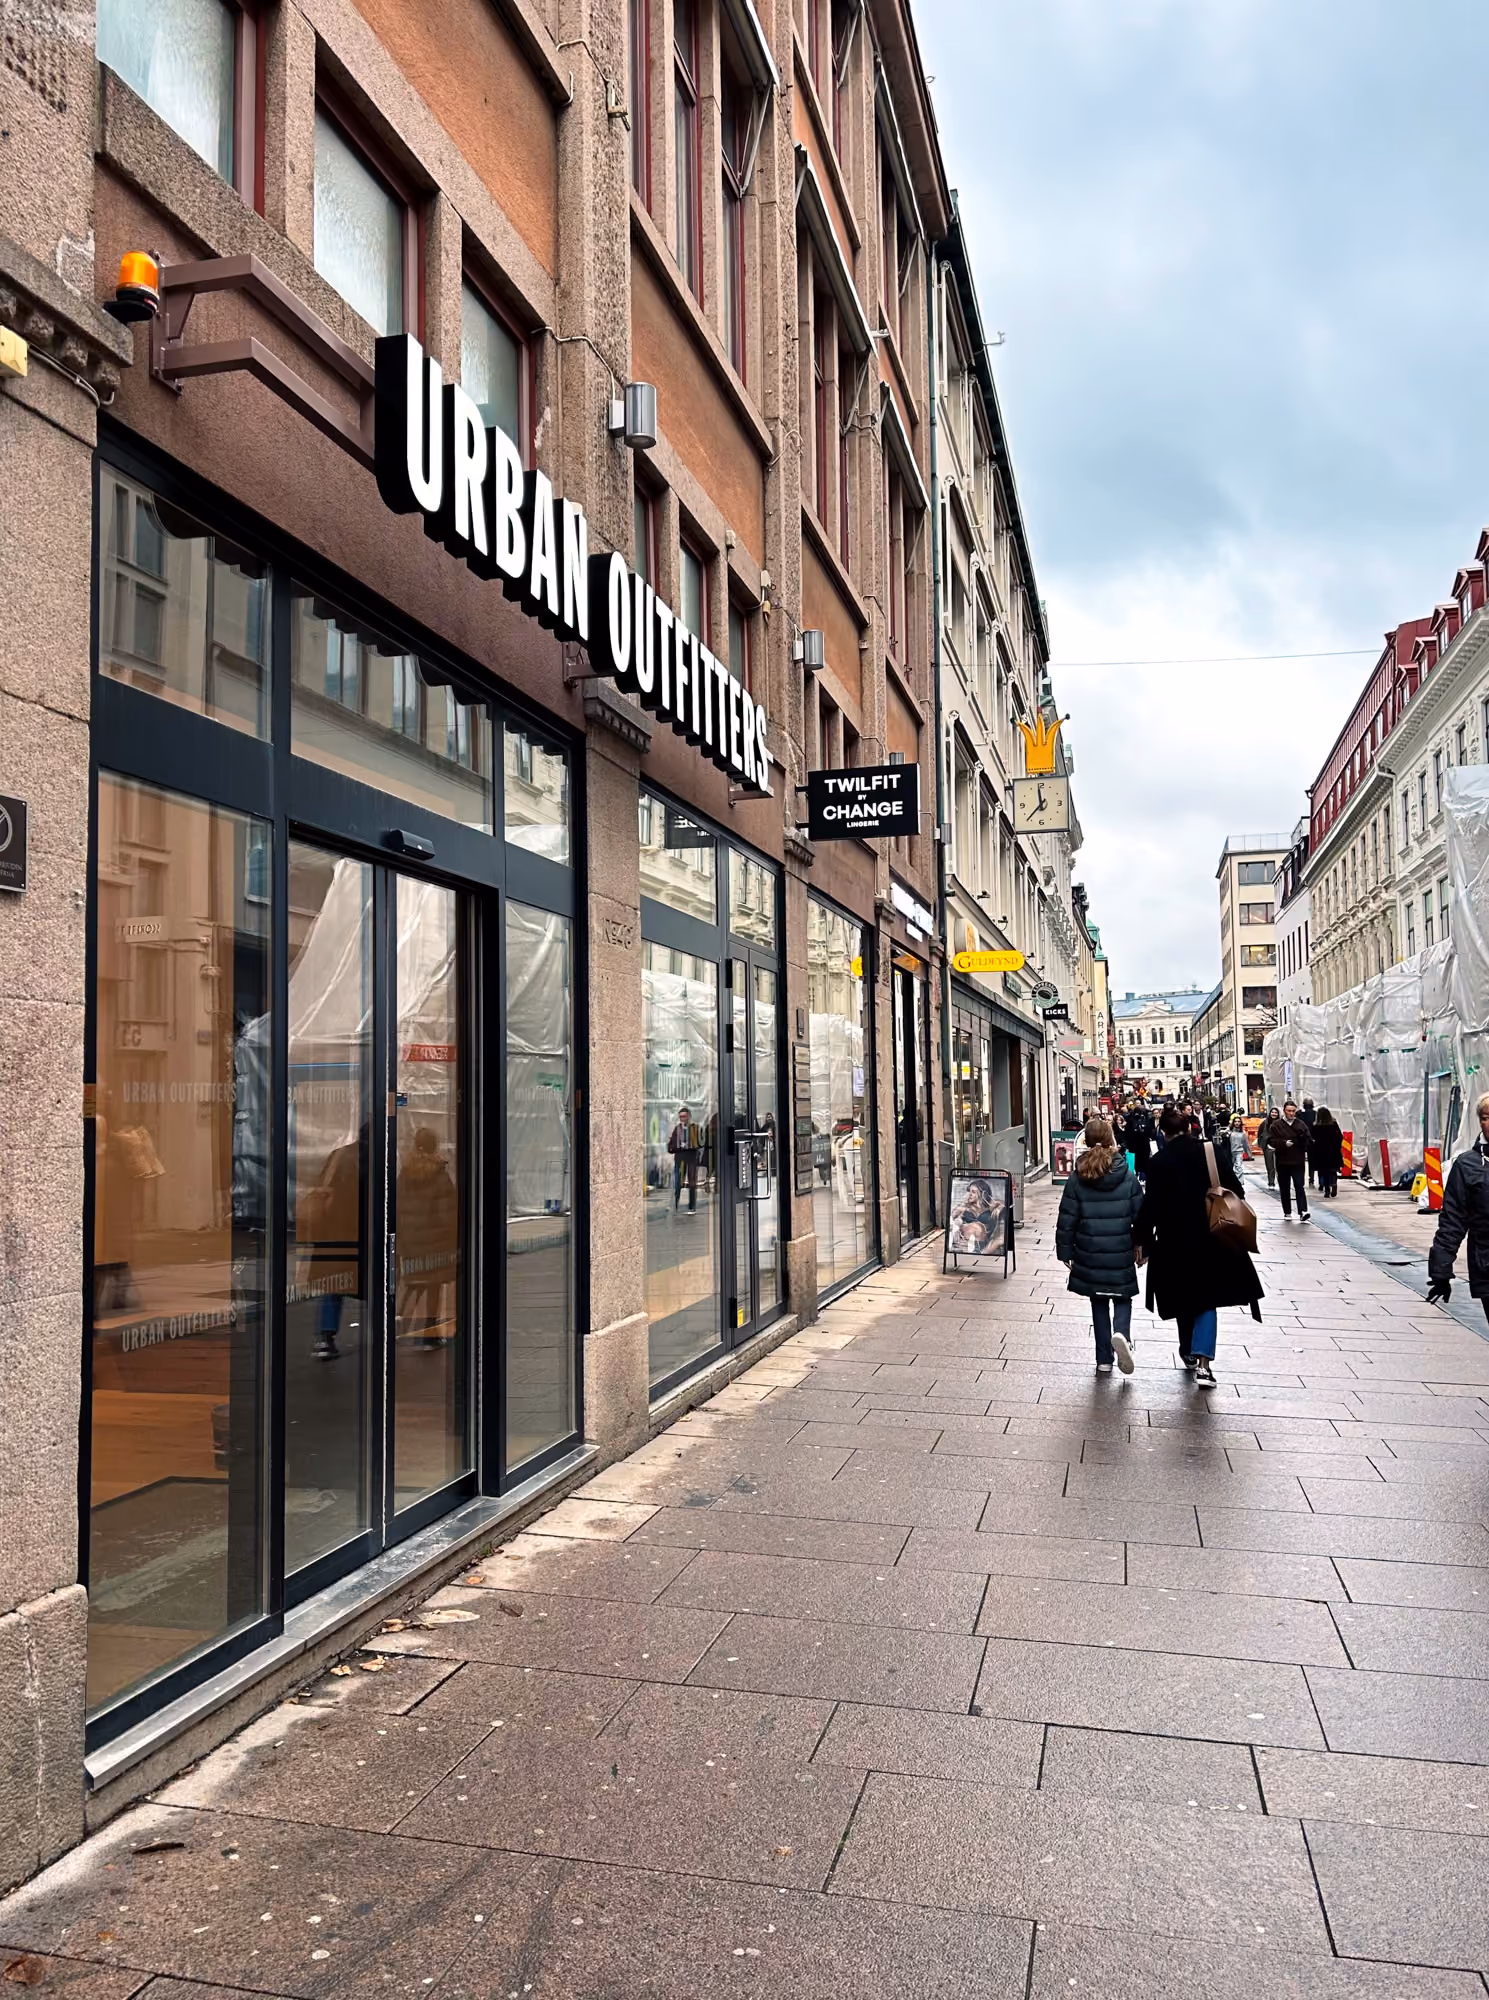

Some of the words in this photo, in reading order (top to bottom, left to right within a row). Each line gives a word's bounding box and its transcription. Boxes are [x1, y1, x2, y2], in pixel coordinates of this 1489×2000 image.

[407, 333, 588, 641] URBAN
[609, 551, 769, 792] OUTFITTERS
[824, 773, 901, 793] TWILFIT
[823, 801, 903, 820] CHANGE
[846, 820, 879, 828] LINGERIE
[958, 955, 1018, 969] GULDFYND
[1097, 1011, 1105, 1057] ARKET
[122, 1081, 165, 1103] URBAN
[170, 1082, 236, 1102] OUTFITTERS
[286, 1284, 302, 1304] BAN
[305, 1271, 354, 1299] OUTFITTERS
[122, 1321, 164, 1352] URBAN
[170, 1302, 237, 1339] OUTFITTERS
